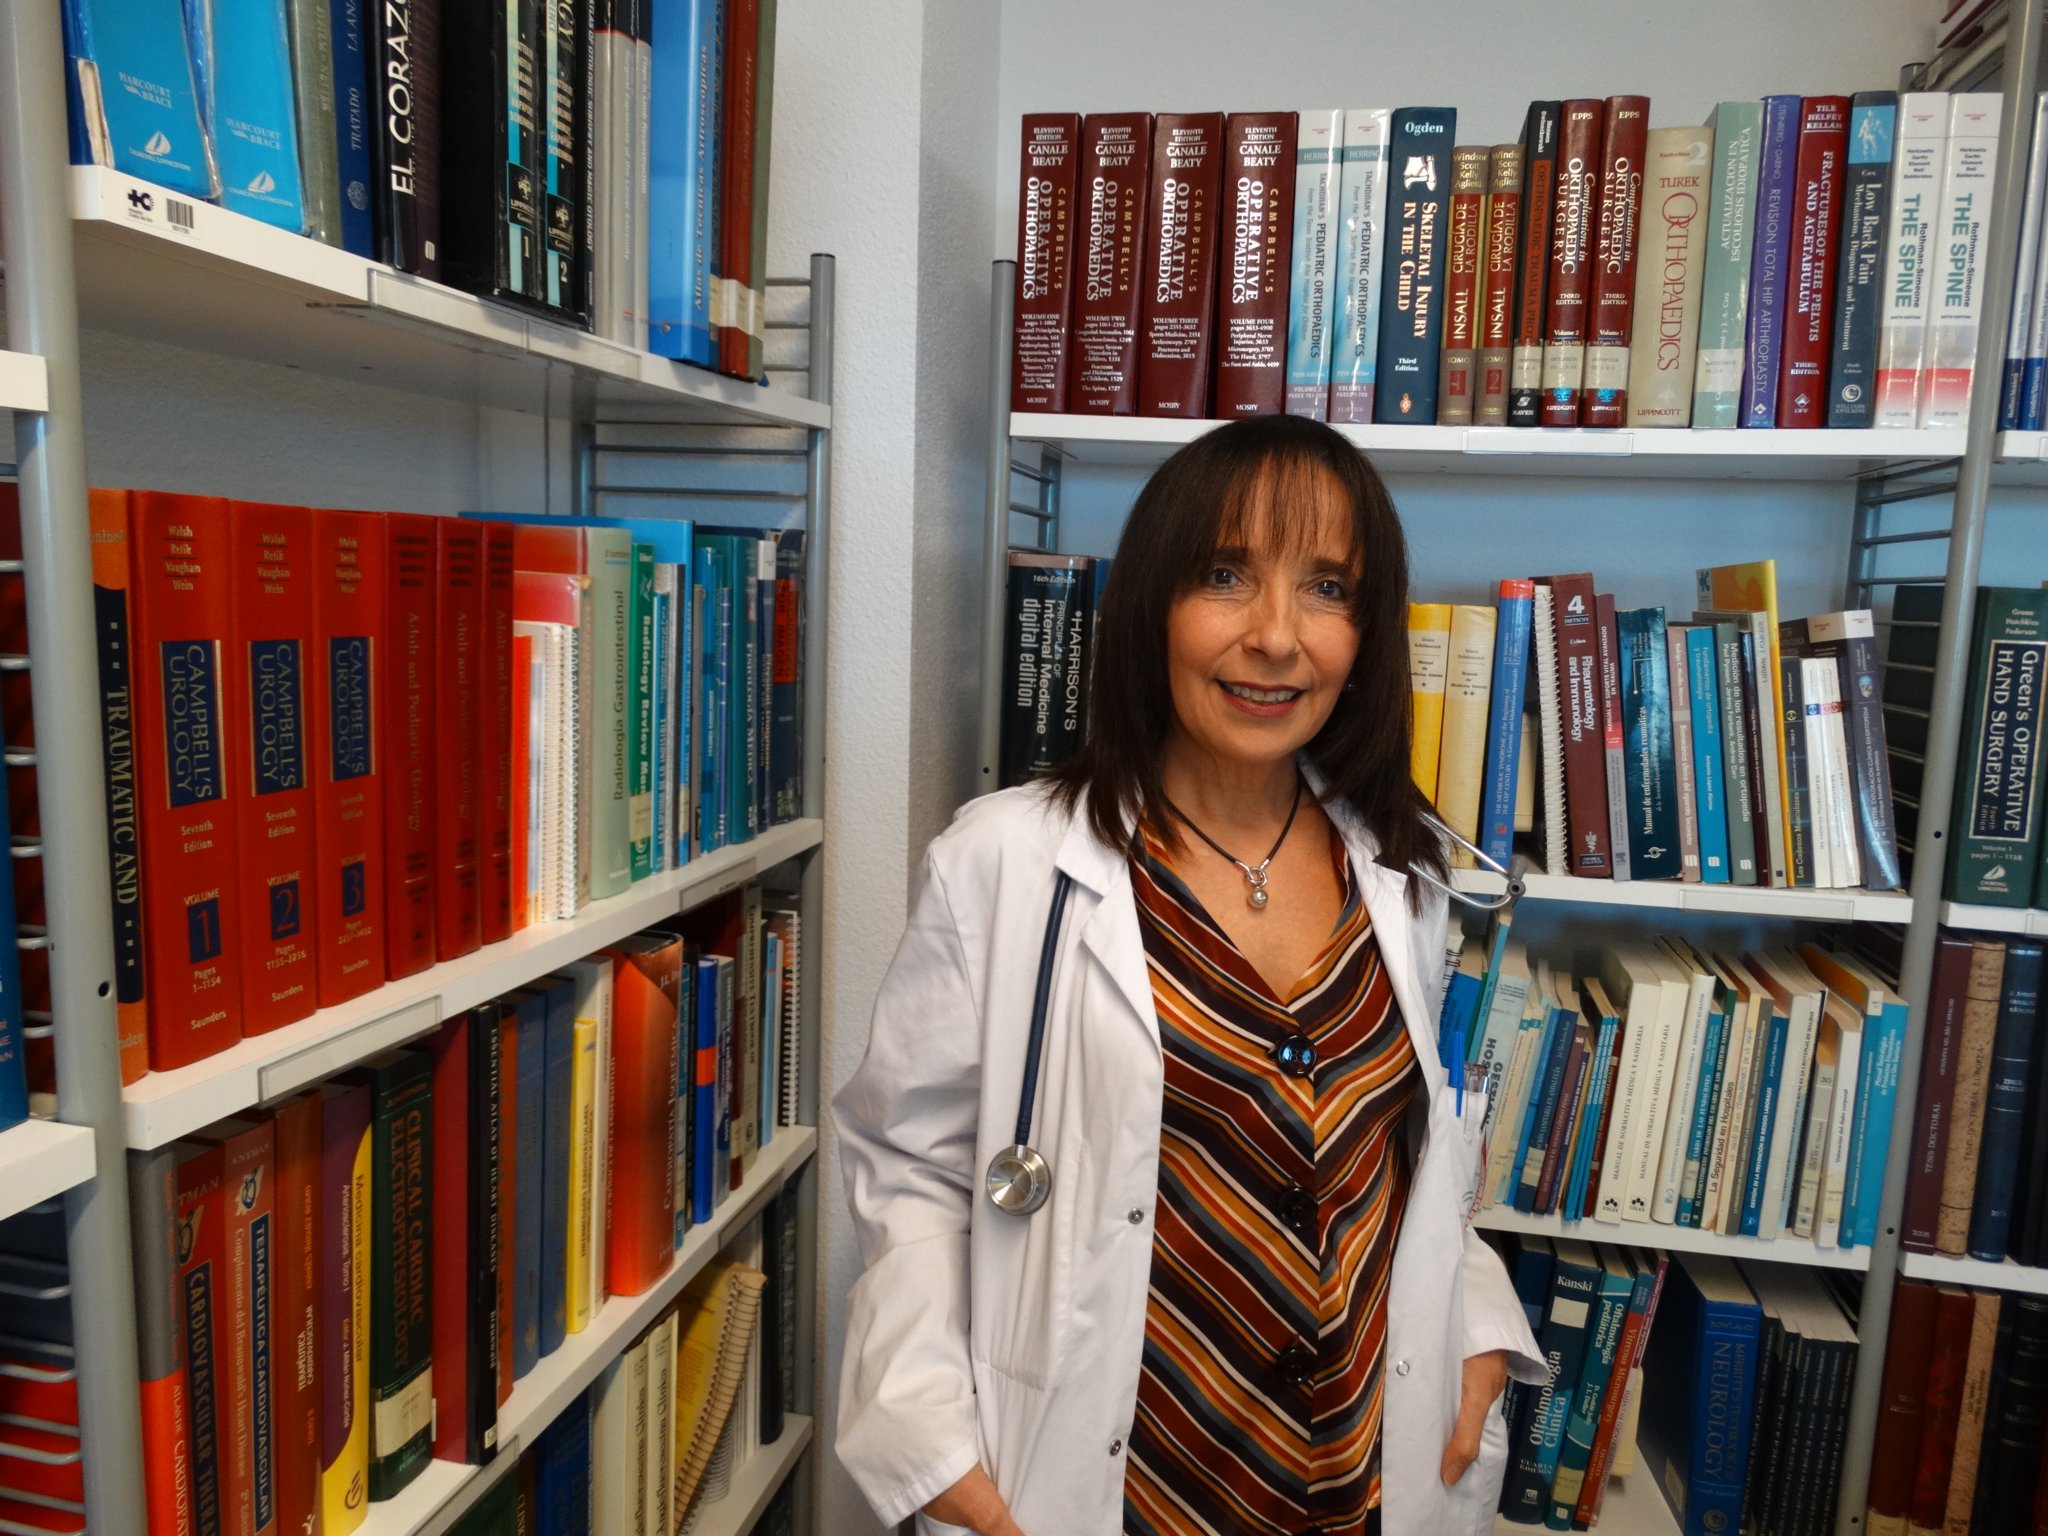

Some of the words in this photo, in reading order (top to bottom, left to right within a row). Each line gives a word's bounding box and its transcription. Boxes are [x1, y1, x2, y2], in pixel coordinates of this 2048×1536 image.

[1404, 122, 1444, 136] Ogden
[1618, 111, 1640, 119] EPPS
[1815, 104, 1837, 113] TILE
[1028, 144, 1068, 154] CANALE
[1033, 157, 1064, 166] BEATY
[1096, 144, 1135, 155] CANALE
[1100, 157, 1130, 166] BEATY
[1167, 145, 1207, 156] CANALE
[1171, 158, 1202, 168] BEATY
[1239, 144, 1281, 155] CANALE
[1244, 157, 1276, 166] BEATY
[1659, 176, 1700, 188] TUREK
[1806, 181, 1818, 212] AND
[1865, 184, 1882, 212] Low
[1455, 202, 1467, 218] DE
[1554, 173, 1568, 261] SURGERY
[1562, 157, 1583, 274] ORTHOPAEDIC
[1599, 172, 1614, 261] SURGERY
[1607, 157, 1629, 274] ORTHOPAEDIC
[1901, 193, 1921, 236] THE
[1952, 192, 1973, 236] THE
[1023, 177, 1040, 299] ORTHOPAEDICS
[1035, 180, 1052, 296] OPERATIVE
[1087, 177, 1105, 301] ORTHOPAEDICS
[1099, 181, 1118, 298] OPERATIVE
[1157, 178, 1176, 303] ORTHOPAEDICS
[1171, 183, 1190, 299] OPERATIVE
[1246, 180, 1263, 300] OPERATIVE
[1452, 220, 1466, 274] CIRUGÍA
[1861, 215, 1880, 249] Back
[560, 261, 568, 283] 2
[1657, 192, 1698, 371] ORTHOPAEDICS
[1798, 215, 1816, 312] ACETABULUM
[1858, 253, 1876, 285] Pain
[1894, 243, 1919, 309] SPINE
[1912, 222, 1928, 309] Rothman-Simeone
[1944, 242, 1968, 309] SPINE
[1964, 222, 1979, 309] Rothman-Simeone
[1453, 289, 1469, 340] INSALL
[1489, 287, 1506, 339] INSALL
[1394, 364, 1419, 372] Edition
[1397, 357, 1417, 365] Third
[1636, 408, 1682, 417] LIPPINCOTT
[164, 562, 201, 574] Vaughan
[172, 580, 194, 591] Wein
[256, 567, 290, 578] Vaughan
[264, 583, 284, 594] Wein
[1020, 598, 1041, 648] digital
[1568, 595, 1585, 614] 4
[1041, 599, 1056, 659] Internal
[1601, 626, 1609, 657] AVANZADO
[640, 615, 651, 698] Radiology
[1064, 617, 1083, 731] HARRISON'S
[1569, 656, 1580, 675] and
[1730, 642, 1739, 685] Medición
[1992, 649, 2014, 704] HAND
[1018, 653, 1038, 707] edition
[1036, 663, 1052, 735] Medicine
[1582, 656, 1596, 730] Rheumatology
[1604, 675, 1612, 699] SOPORTE
[1611, 686, 1616, 695] EN
[1733, 686, 1740, 698] de
[2014, 650, 2039, 722] Green's
[168, 654, 193, 793] UROLOGY
[187, 644, 212, 799] CAMPBELL'S
[258, 654, 279, 782] UROLOGY
[276, 643, 296, 787] CAMPBELL'S
[335, 650, 352, 768] UROLOGY
[350, 640, 366, 774] CAMPBELL'S
[1570, 677, 1582, 742] Immunology
[1605, 700, 1612, 708] DE
[1605, 709, 1613, 732] MANUAL
[1734, 698, 1742, 713] los
[640, 699, 651, 758] Review
[1639, 706, 1650, 747] reumáticas
[1735, 715, 1747, 764] resultados
[107, 685, 135, 844] TRAUMATIC
[1739, 765, 1745, 777] en
[1983, 707, 2009, 797] SURGERY
[1640, 750, 1651, 796] enfermedades
[2004, 726, 2030, 832] OPERATIVE
[265, 808, 297, 822] Seventh
[1646, 797, 1651, 806] de
[1740, 779, 1750, 822] ortopedia
[1792, 791, 1803, 832] Musculares
[1979, 804, 1989, 832] Edition
[1989, 806, 1997, 831] Fourth
[180, 820, 214, 836] Seventh
[1644, 811, 1653, 835] Manual
[1794, 832, 1804, 865] Cadenas
[114, 851, 138, 905] AND
[266, 871, 300, 887] VOLUME
[1795, 865, 1805, 878] Las
[183, 888, 220, 906] VOLUME
[276, 888, 294, 932] 2
[197, 910, 211, 953] 1
[193, 966, 216, 980] Pages
[271, 983, 304, 1002] Saunders
[190, 1009, 226, 1030] Saunders
[1632, 1025, 1645, 1062] SANITARIA
[1891, 1040, 1901, 1062] Sanitario
[1625, 1070, 1636, 1097] MÉDICA
[1889, 1074, 1897, 1086] para
[1890, 1063, 1898, 1074] Uso
[1699, 1074, 1712, 1115] FUNDACIONES
[1719, 1081, 1735, 1123] Hospitales
[1619, 1098, 1633, 1139] NORMATIVA
[1695, 1130, 1703, 1139] DE
[1697, 1116, 1706, 1129] LAS
[1718, 1125, 1726, 1136] en
[1927, 1102, 1942, 1146] DOCTORAL
[405, 1109, 423, 1216] CLINICAL
[1612, 1151, 1624, 1180] MANUAL
[1617, 1140, 1625, 1150] DE
[1711, 1138, 1727, 1180] Seguridad
[1924, 1146, 1937, 1174] TESIS
[1709, 1181, 1718, 1193] La
[355, 1174, 364, 1248] Medicina
[256, 1224, 267, 1353] TERAPÉUTICA
[408, 1219, 423, 1325] CARDIAC
[1557, 1275, 1592, 1293] Kanski
[355, 1250, 364, 1362] cardiovascular
[1594, 1300, 1613, 1348] pediátrica
[306, 1304, 314, 1385] CARDIOVASCULAR
[1602, 1303, 1624, 1365] Oftalmología
[1620, 1328, 1637, 1371] Vitreous
[1604, 1366, 1627, 1424] Microsurgery
[1704, 1341, 1732, 1480] NEUROLOGY
[257, 1356, 269, 1520] CARDIOVASCULAR
[1520, 1458, 1553, 1470] CUARTA
